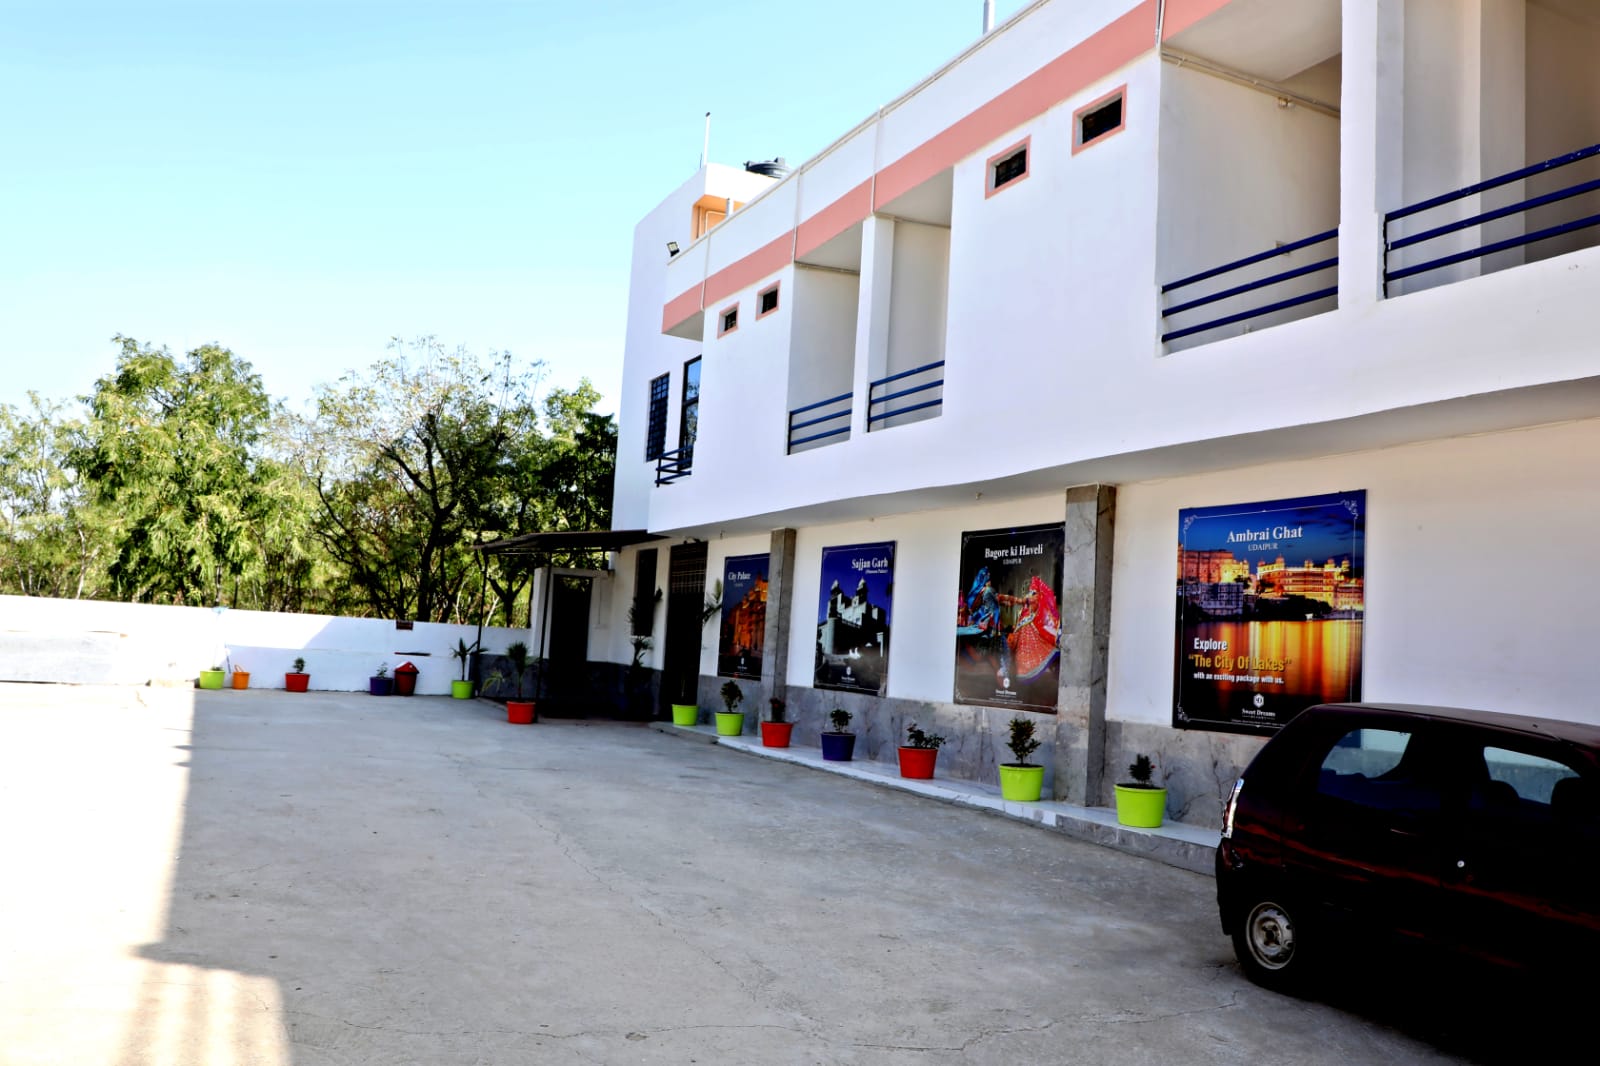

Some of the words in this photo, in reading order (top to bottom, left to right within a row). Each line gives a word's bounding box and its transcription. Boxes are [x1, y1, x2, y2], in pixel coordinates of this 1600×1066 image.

[1226, 527, 1270, 543] Ambrai
[1272, 526, 1304, 540] Ghat
[984, 547, 1009, 560] Bagore
[1010, 546, 1018, 557] ki
[1019, 544, 1043, 556] Haveli
[851, 558, 871, 571] Sajjan
[871, 556, 889, 568] Garh
[1193, 638, 1228, 652] Explore
[1214, 655, 1235, 671] City
[1237, 655, 1249, 670] Of
[1213, 673, 1235, 682] exciting
[1235, 674, 1260, 684] package
[1261, 675, 1274, 683] with
